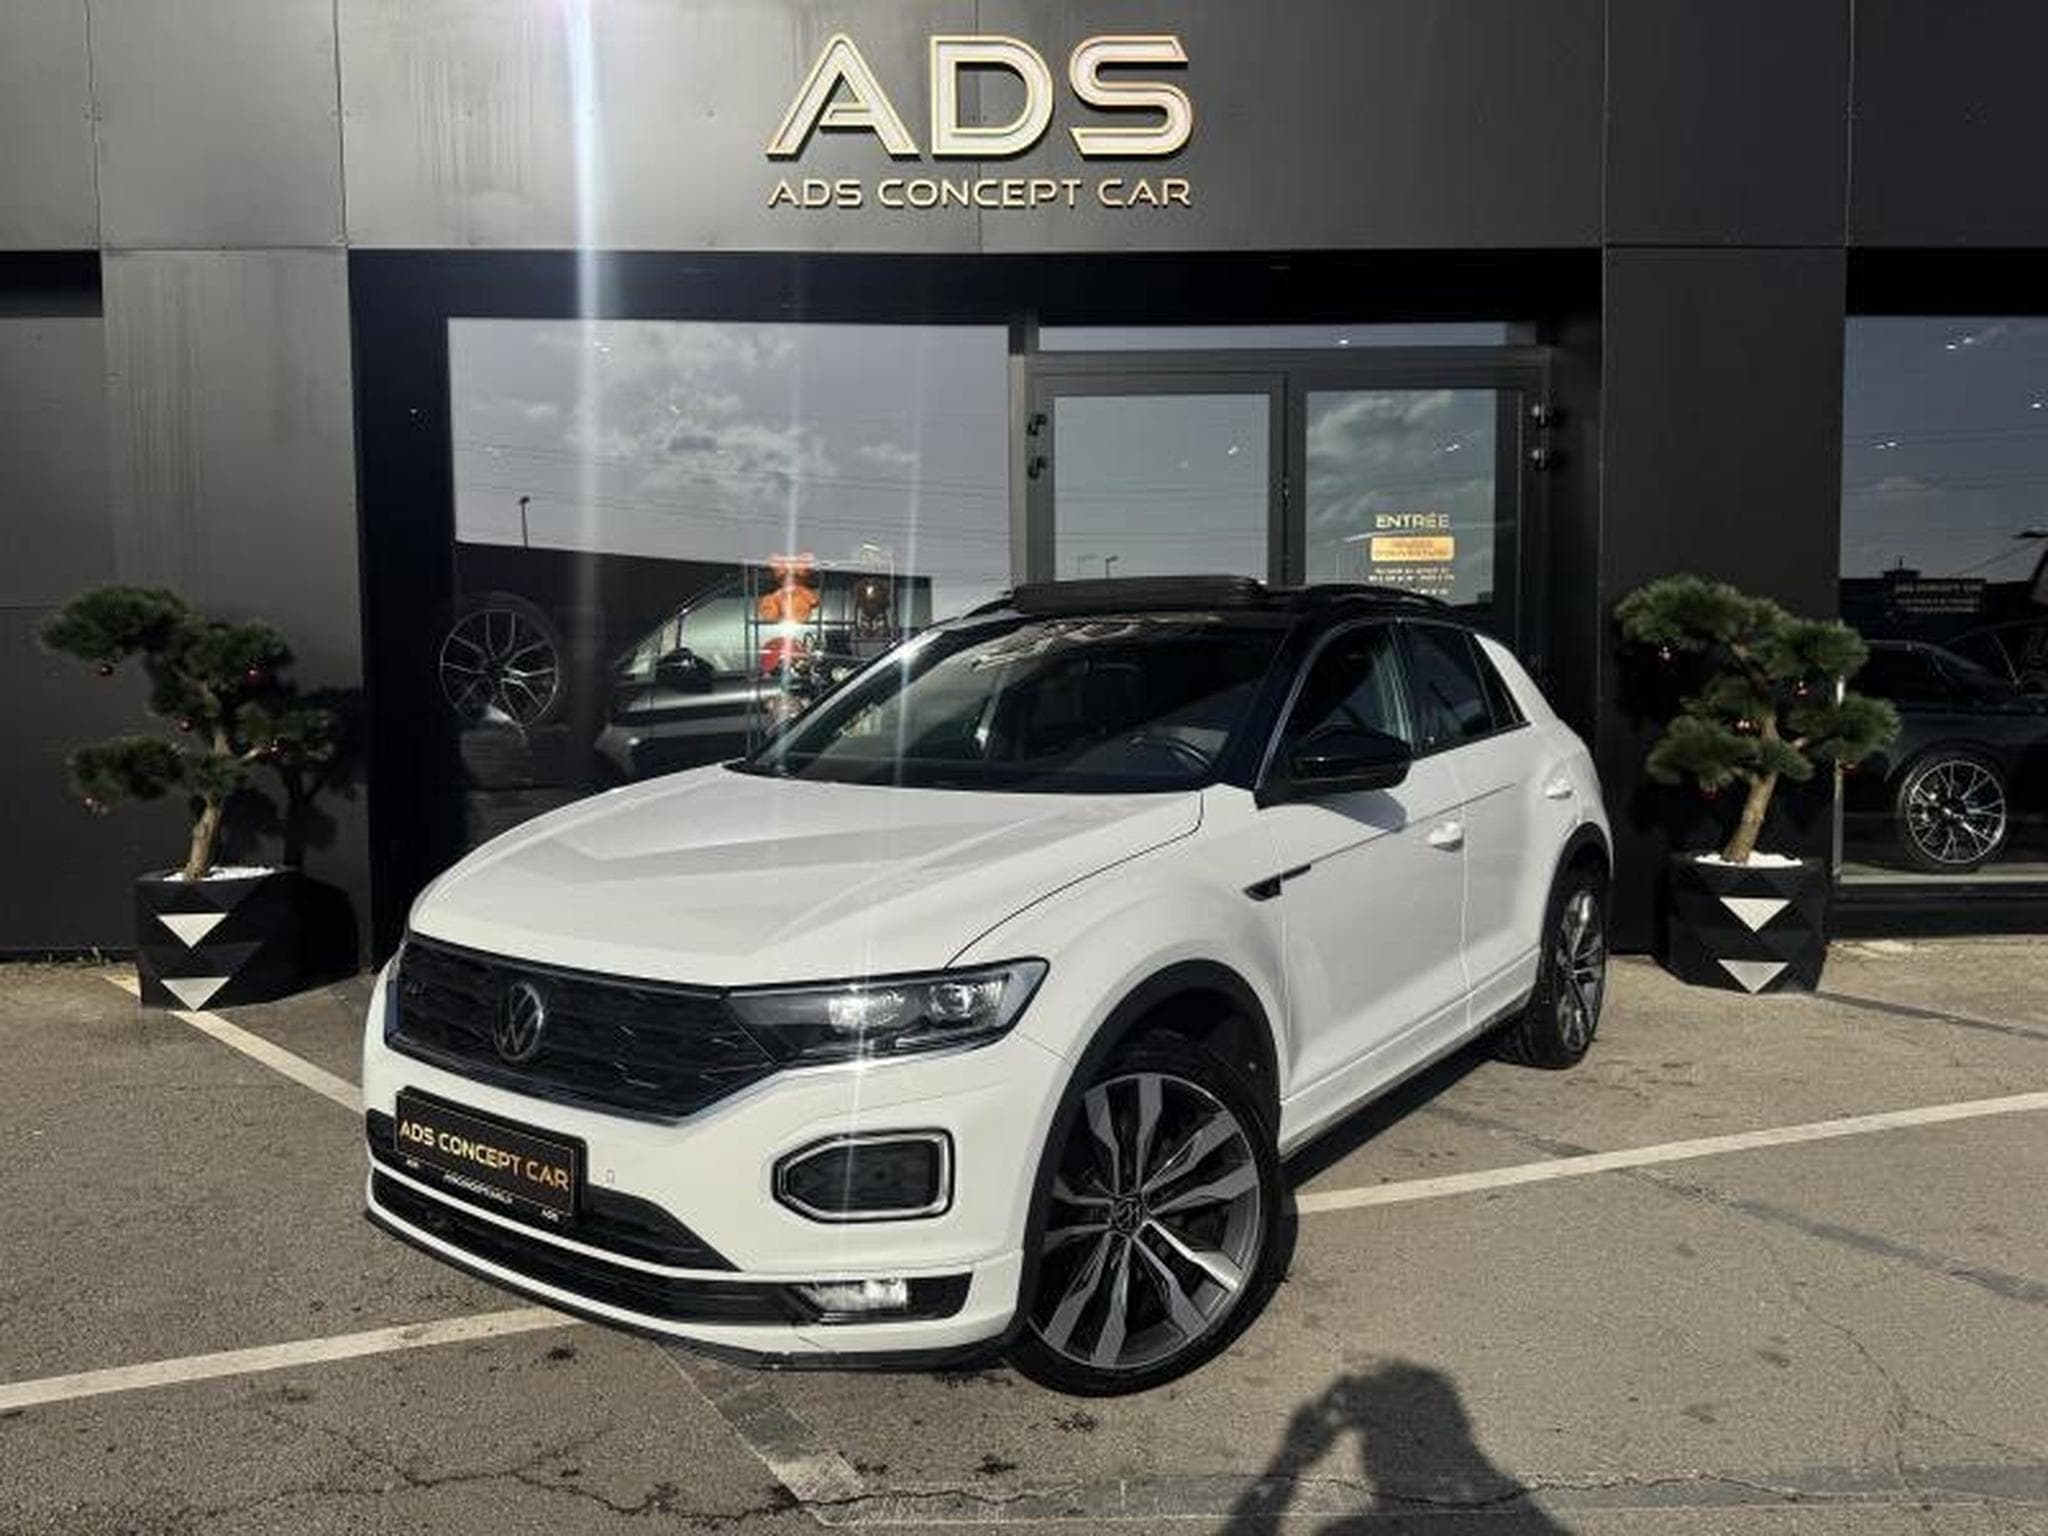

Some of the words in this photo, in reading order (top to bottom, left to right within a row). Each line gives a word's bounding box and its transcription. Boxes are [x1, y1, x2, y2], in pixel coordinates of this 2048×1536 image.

[766, 33, 1193, 157] ADS
[768, 179, 862, 208] ADS
[878, 179, 1081, 208] CONCEPT
[1098, 179, 1192, 208] CAR
[1375, 511, 1450, 529] ENTRÉE
[400, 1120, 435, 1147] ADS
[438, 1132, 521, 1176] CONCEPT
[526, 1161, 569, 1192] CAR
